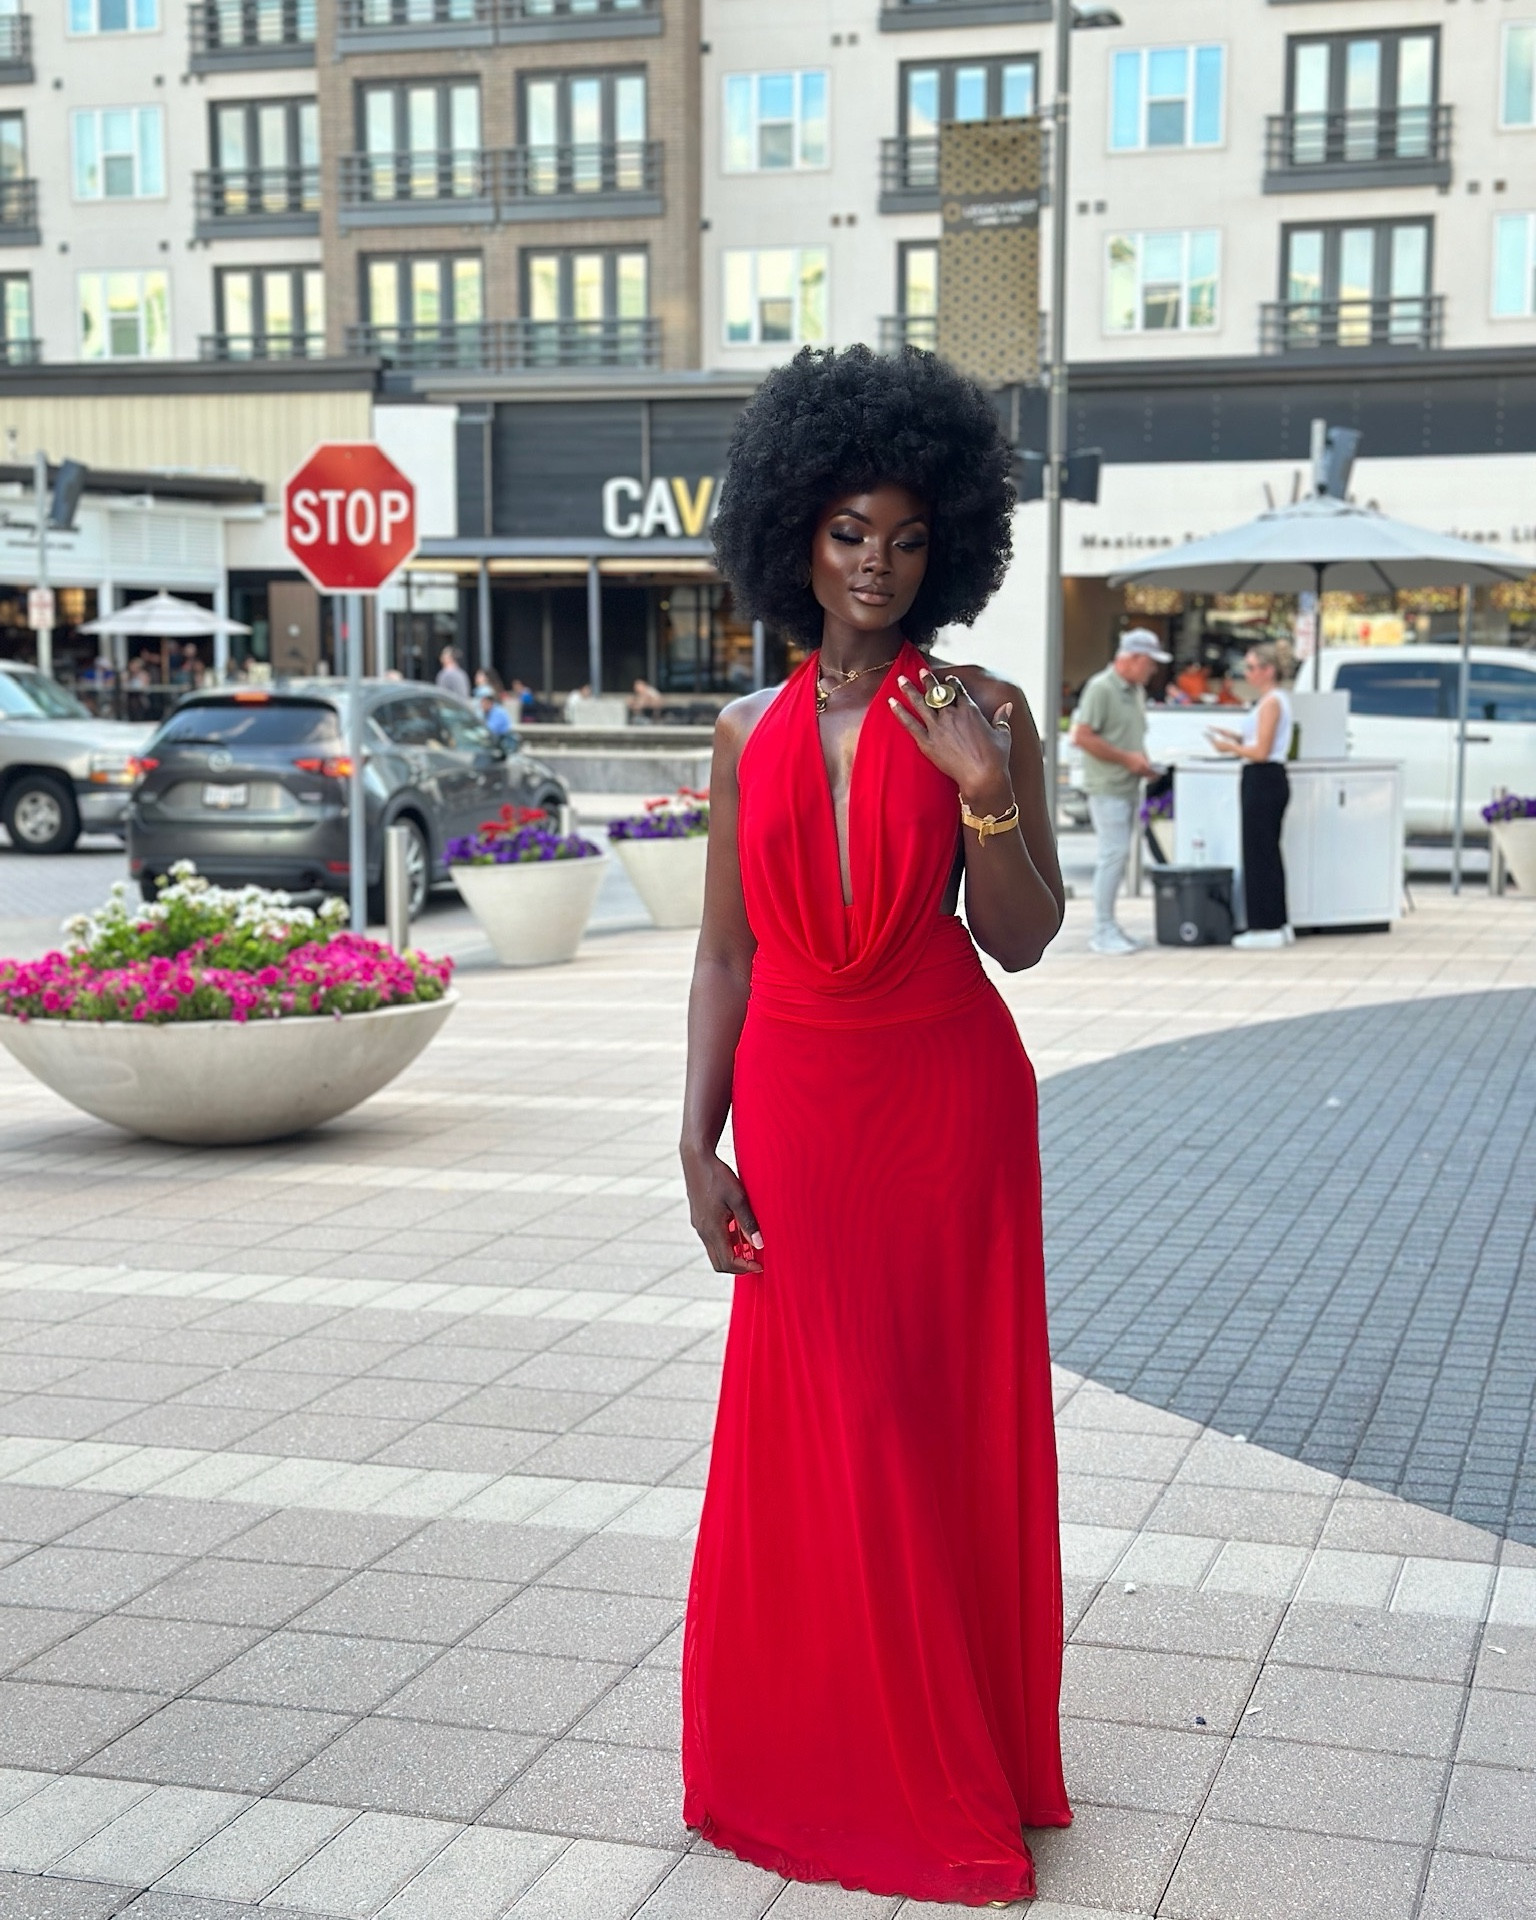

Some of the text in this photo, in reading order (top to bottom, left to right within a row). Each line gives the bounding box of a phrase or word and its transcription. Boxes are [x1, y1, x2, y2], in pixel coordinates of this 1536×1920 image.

[291, 488, 410, 546] STOP
[602, 475, 726, 538] CAV
[1081, 534, 1172, 550] Mexican
